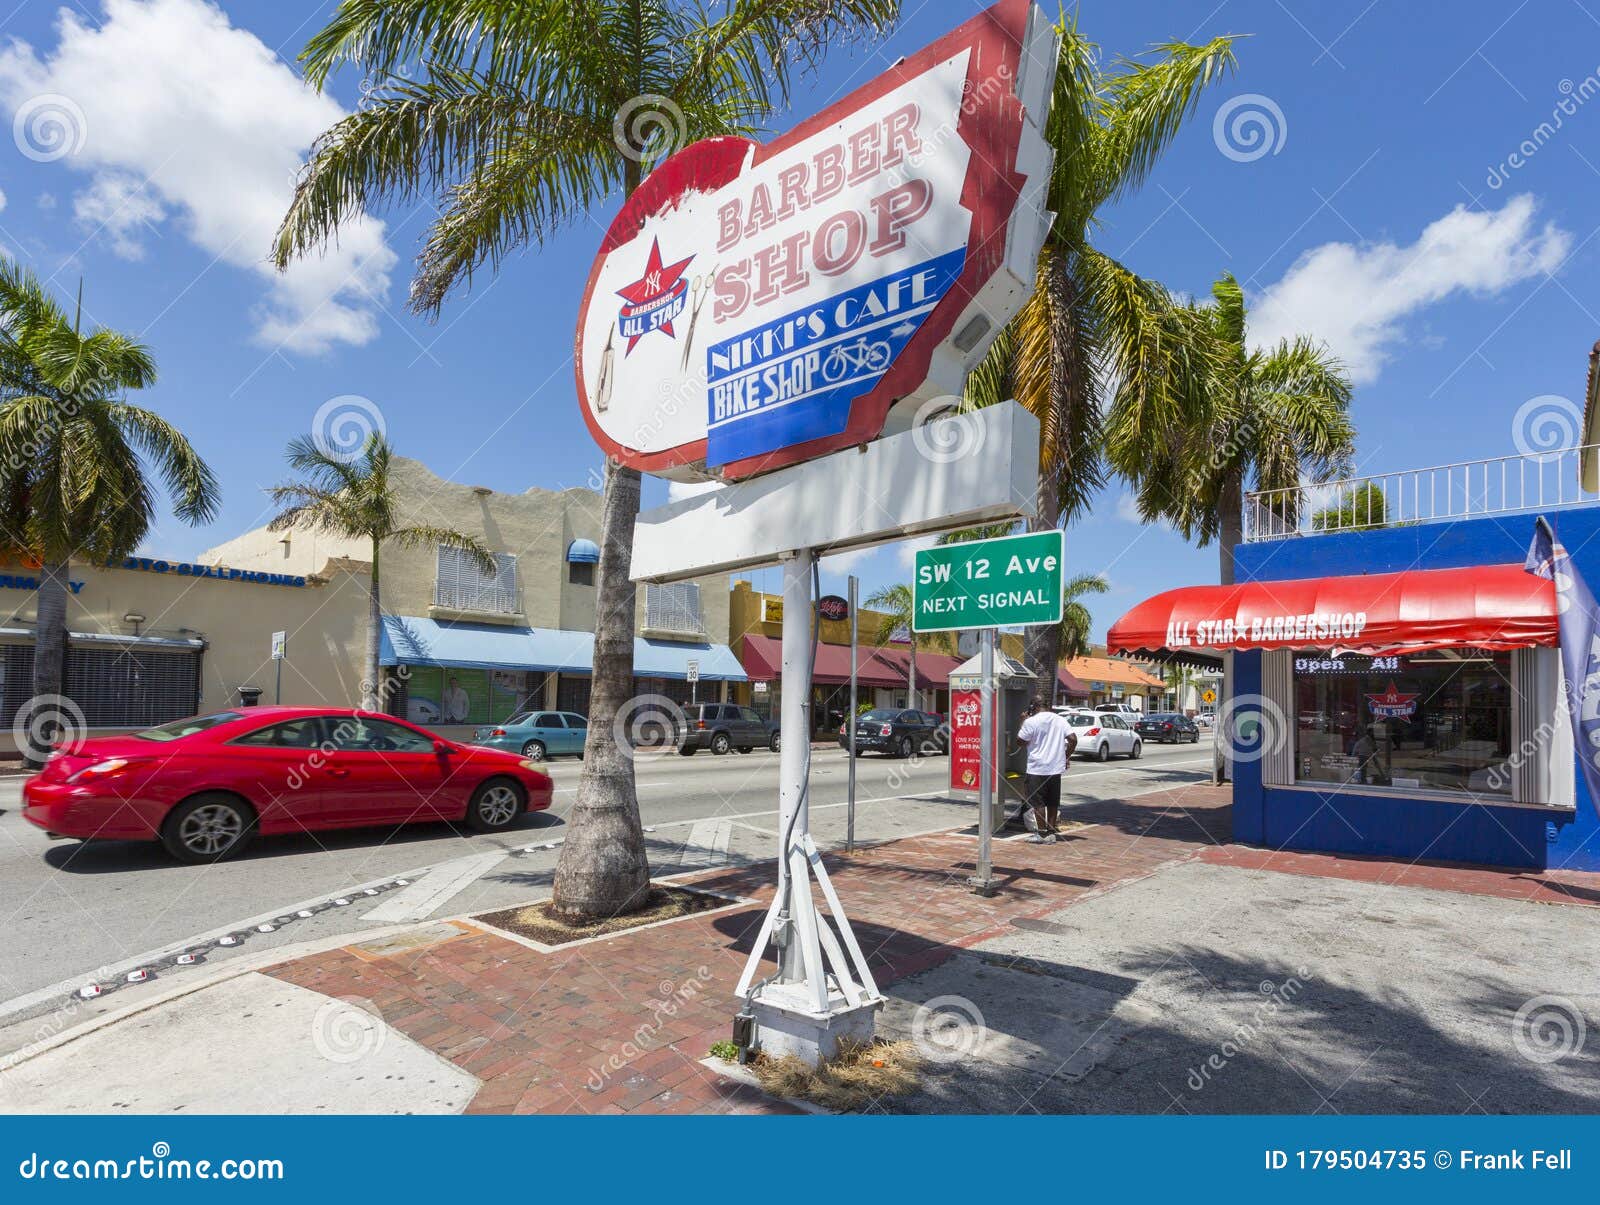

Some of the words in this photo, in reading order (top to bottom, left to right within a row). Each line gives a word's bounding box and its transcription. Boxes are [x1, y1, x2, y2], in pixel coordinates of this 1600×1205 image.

[715, 102, 923, 254] BARBER
[713, 178, 934, 325] SHOP
[623, 316, 645, 338] ALL
[649, 295, 683, 331] STAR
[629, 291, 675, 317] BARBERSHOP
[711, 308, 826, 377] NIKKI'S
[834, 267, 937, 328] CAFE
[919, 563, 951, 585] SW
[966, 558, 990, 580] 12
[1005, 554, 1057, 577] Ave
[922, 596, 968, 614] NEXT
[978, 588, 1050, 609] SIGNAL
[1165, 621, 1191, 647] ALL
[1196, 619, 1235, 645] STAR
[1251, 611, 1367, 641] BARBERSHOP
[688, 671, 697, 680] 30
[1295, 658, 1345, 674] Open
